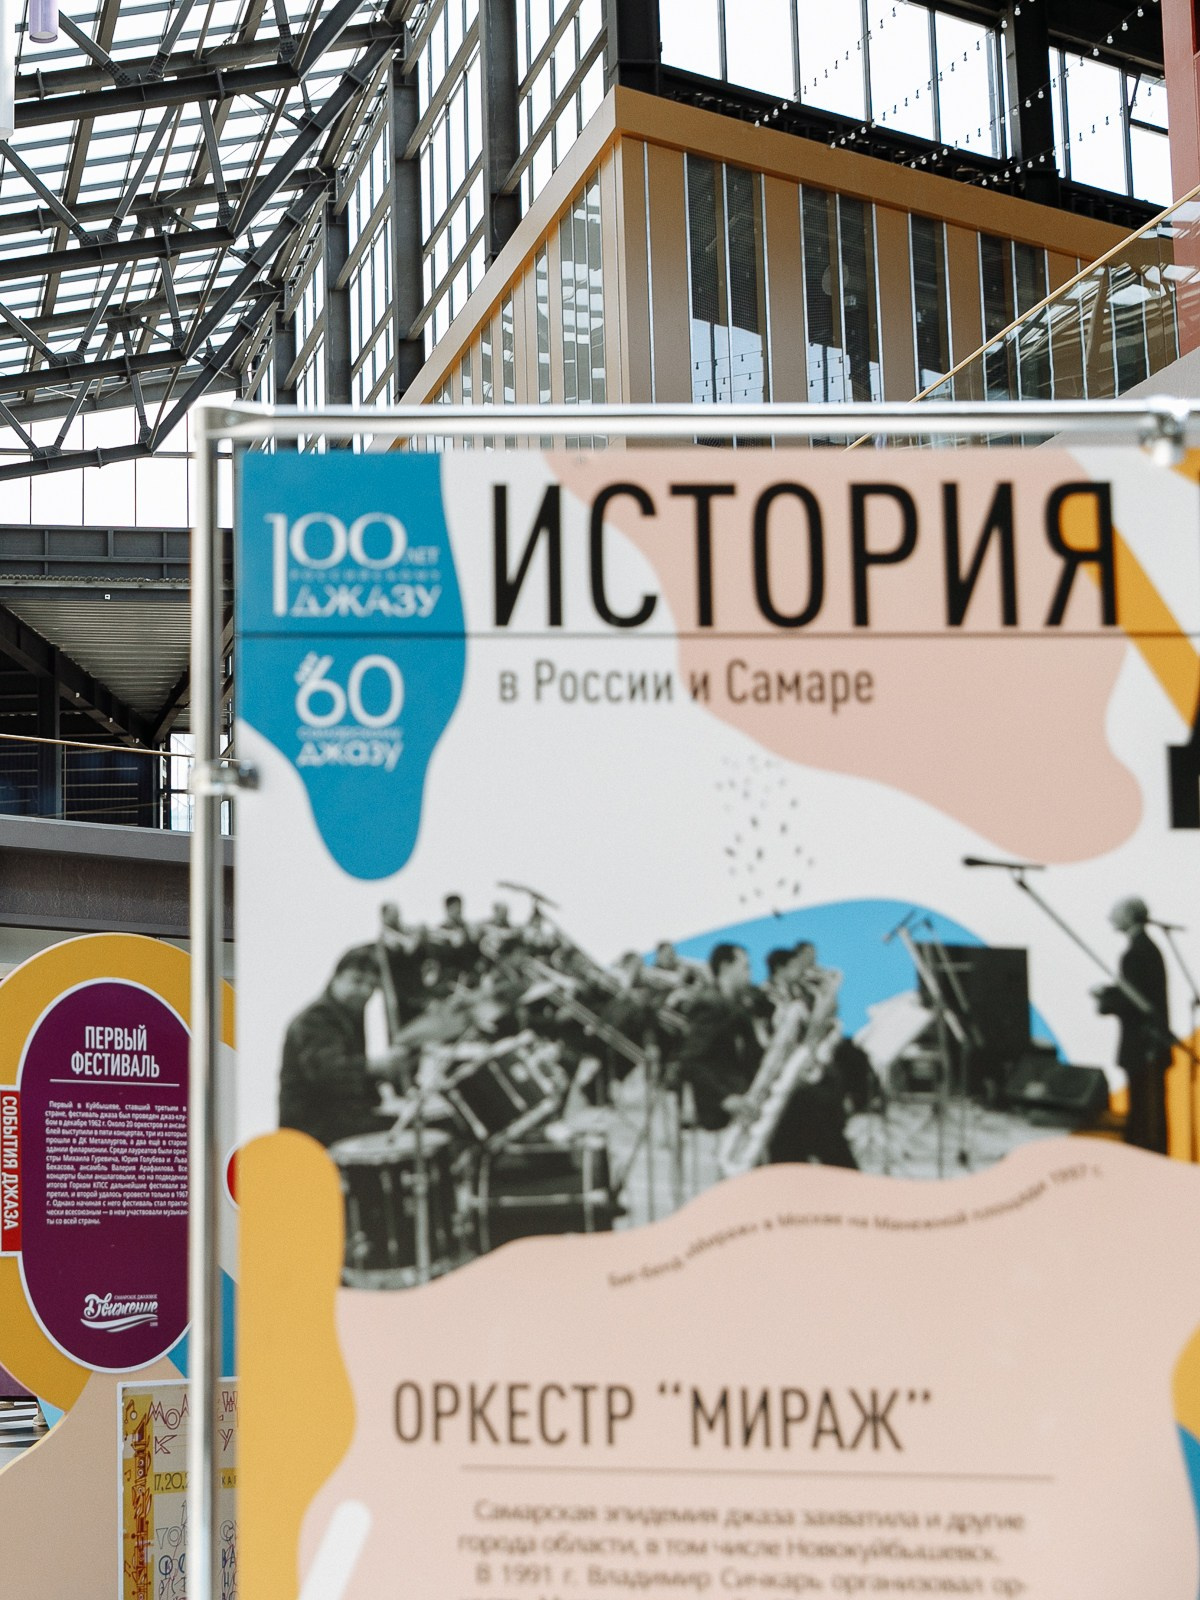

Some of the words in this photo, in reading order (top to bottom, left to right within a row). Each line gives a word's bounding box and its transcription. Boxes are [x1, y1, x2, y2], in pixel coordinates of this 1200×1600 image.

[263, 511, 407, 618] 100
[492, 481, 1119, 627] ИСТОРИЯ
[290, 584, 442, 618] ДЖАЗУ
[294, 654, 405, 729] 60
[499, 669, 519, 703] в
[533, 658, 674, 704] России
[689, 669, 709, 703] и
[726, 657, 874, 715] Самаре
[70, 1051, 160, 1078] ФЕСТИВАЛЬ
[85, 1024, 147, 1051] ПЕРВЫЙ
[2, 1096, 19, 1169] СОБЫТИЯ
[1, 1171, 19, 1231] ДЖАЗА
[392, 1380, 635, 1447] ОРКЕСТР
[457, 1535, 536, 1556] города
[542, 1531, 639, 1556] области,
[646, 1540, 659, 1554] в
[665, 1539, 707, 1555] том
[712, 1540, 782, 1556] числе
[474, 1499, 597, 1524] Самарская
[605, 1505, 718, 1527] эпидемия
[723, 1507, 796, 1529] джаза
[803, 1509, 919, 1528] захватила
[926, 1512, 941, 1528] и
[944, 1512, 1025, 1535] другие
[475, 1563, 491, 1585] В
[502, 1564, 553, 1586] 1991
[587, 1564, 711, 1591] Владимир
[831, 1574, 983, 1596] организовал
